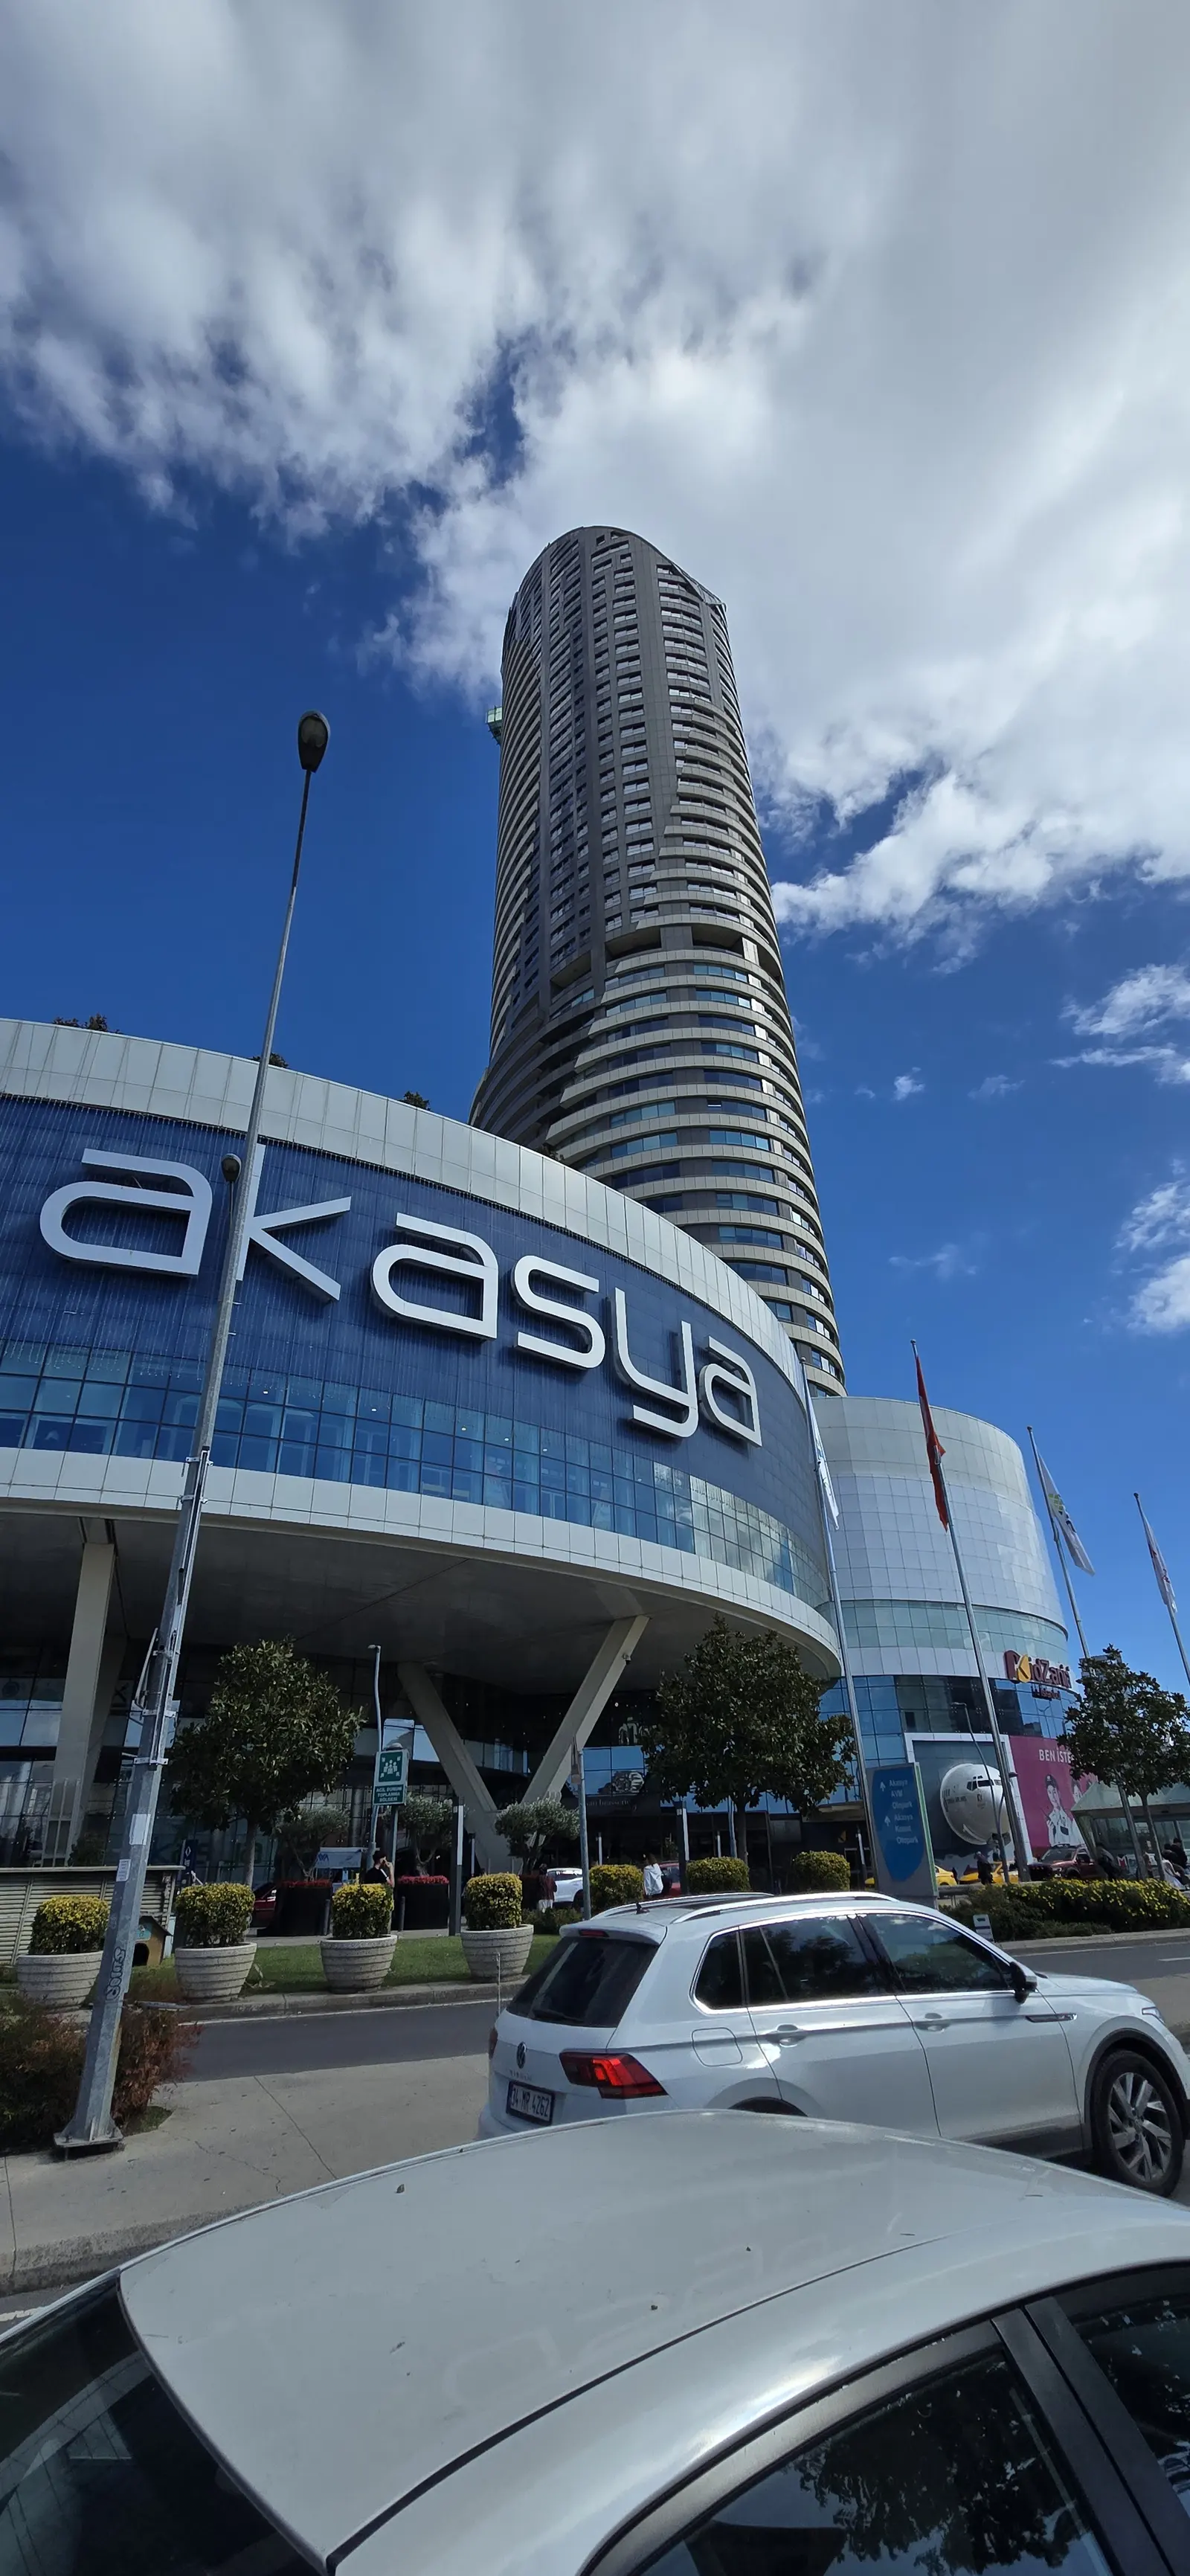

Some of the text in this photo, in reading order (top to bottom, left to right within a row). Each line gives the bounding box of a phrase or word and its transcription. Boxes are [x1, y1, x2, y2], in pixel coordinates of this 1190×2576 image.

[39, 1143, 762, 1447] akasya
[1039, 1748, 1073, 1764] BEN İSTE
